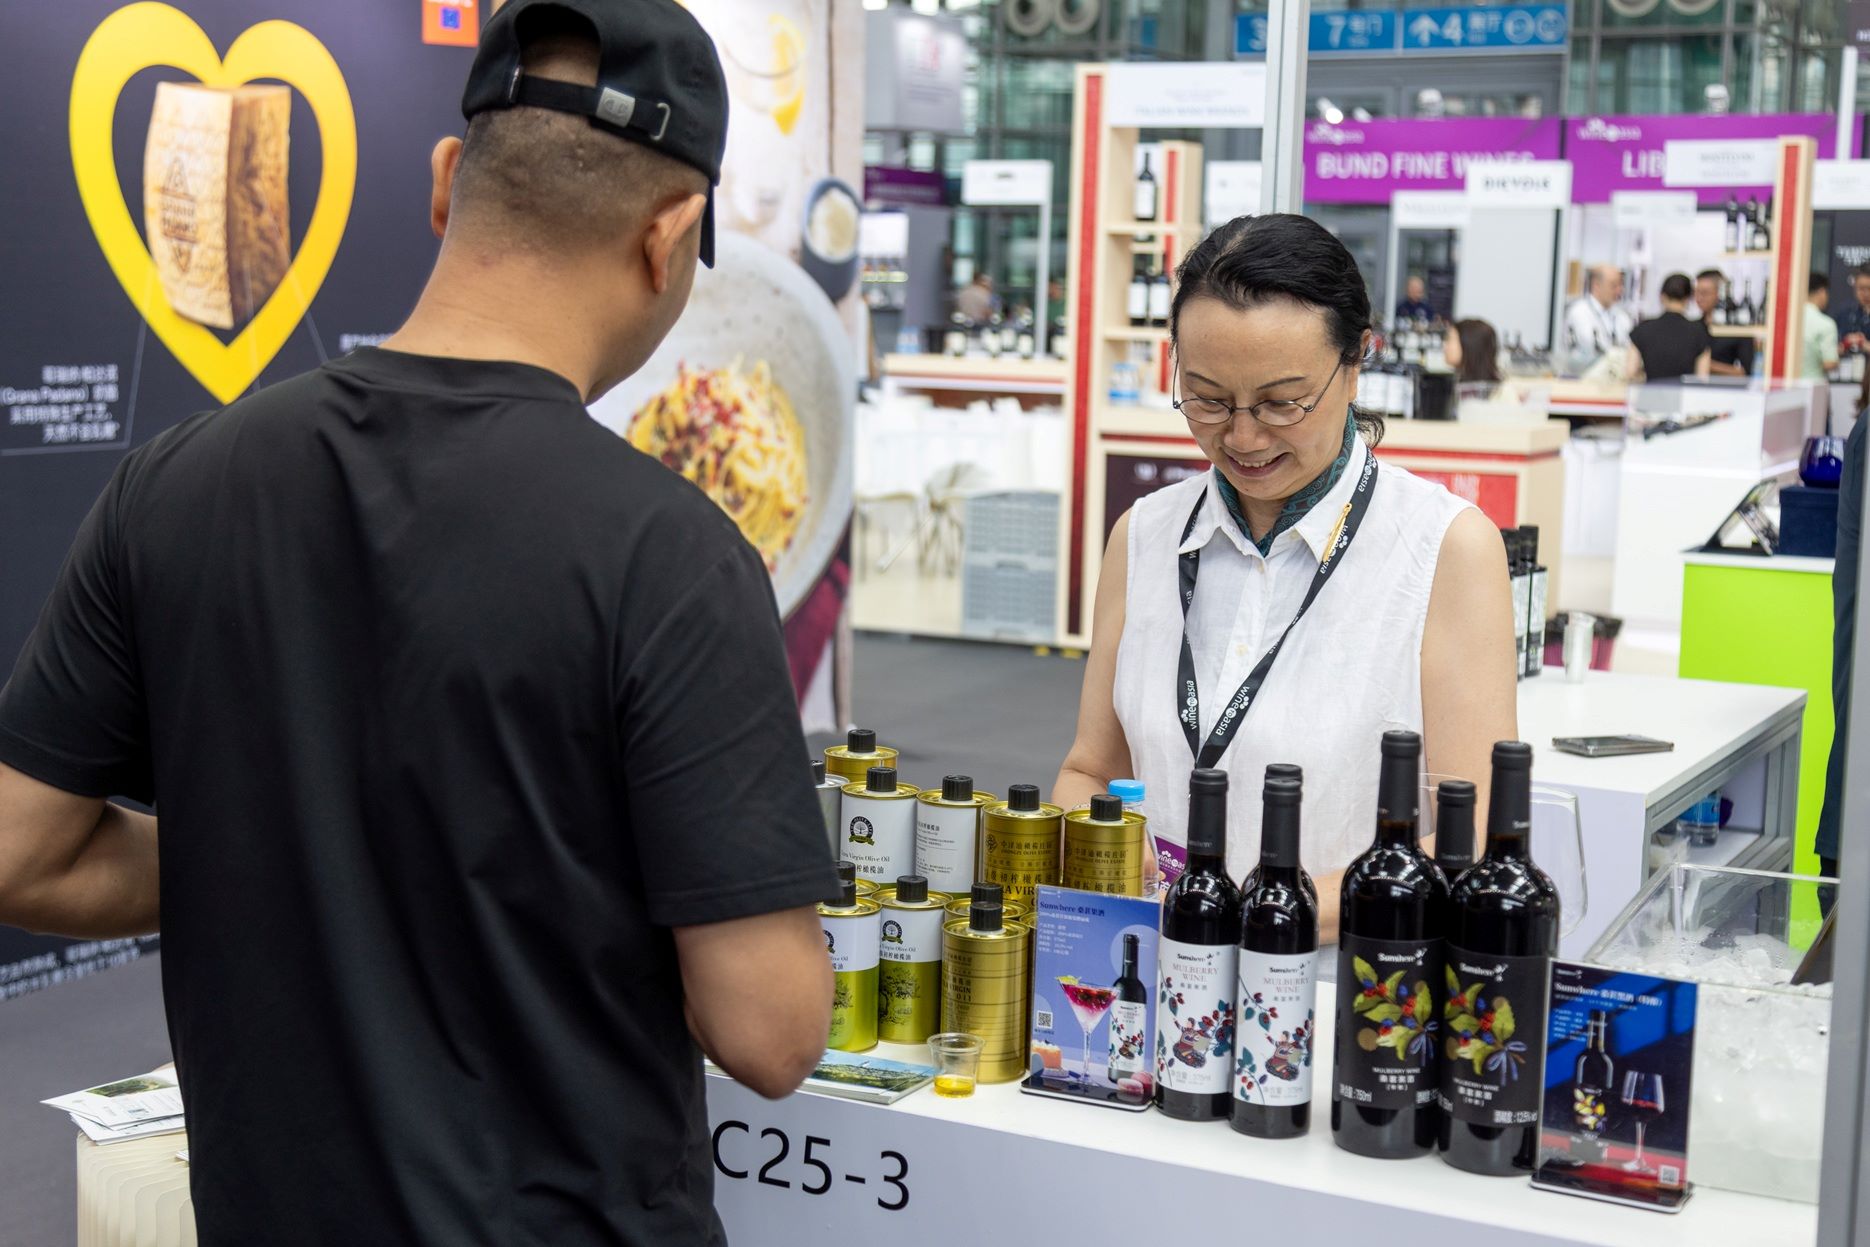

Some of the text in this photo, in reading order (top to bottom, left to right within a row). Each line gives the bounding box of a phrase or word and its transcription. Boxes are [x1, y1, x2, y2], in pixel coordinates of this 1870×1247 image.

[1325, 14, 1346, 48] 7
[1441, 12, 1464, 46] 4
[1316, 151, 1389, 179] BUND
[1391, 151, 1449, 179] FINE
[1040, 902, 1076, 913] Sunwhere
[1172, 963, 1219, 975] MULBERRY
[1183, 973, 1207, 982] WINE
[1263, 977, 1310, 986] MULBERRY
[1554, 982, 1600, 997] Sunwhere
[1453, 1077, 1499, 1092] MULBERRY WINE
[712, 1120, 910, 1211] C25-3
